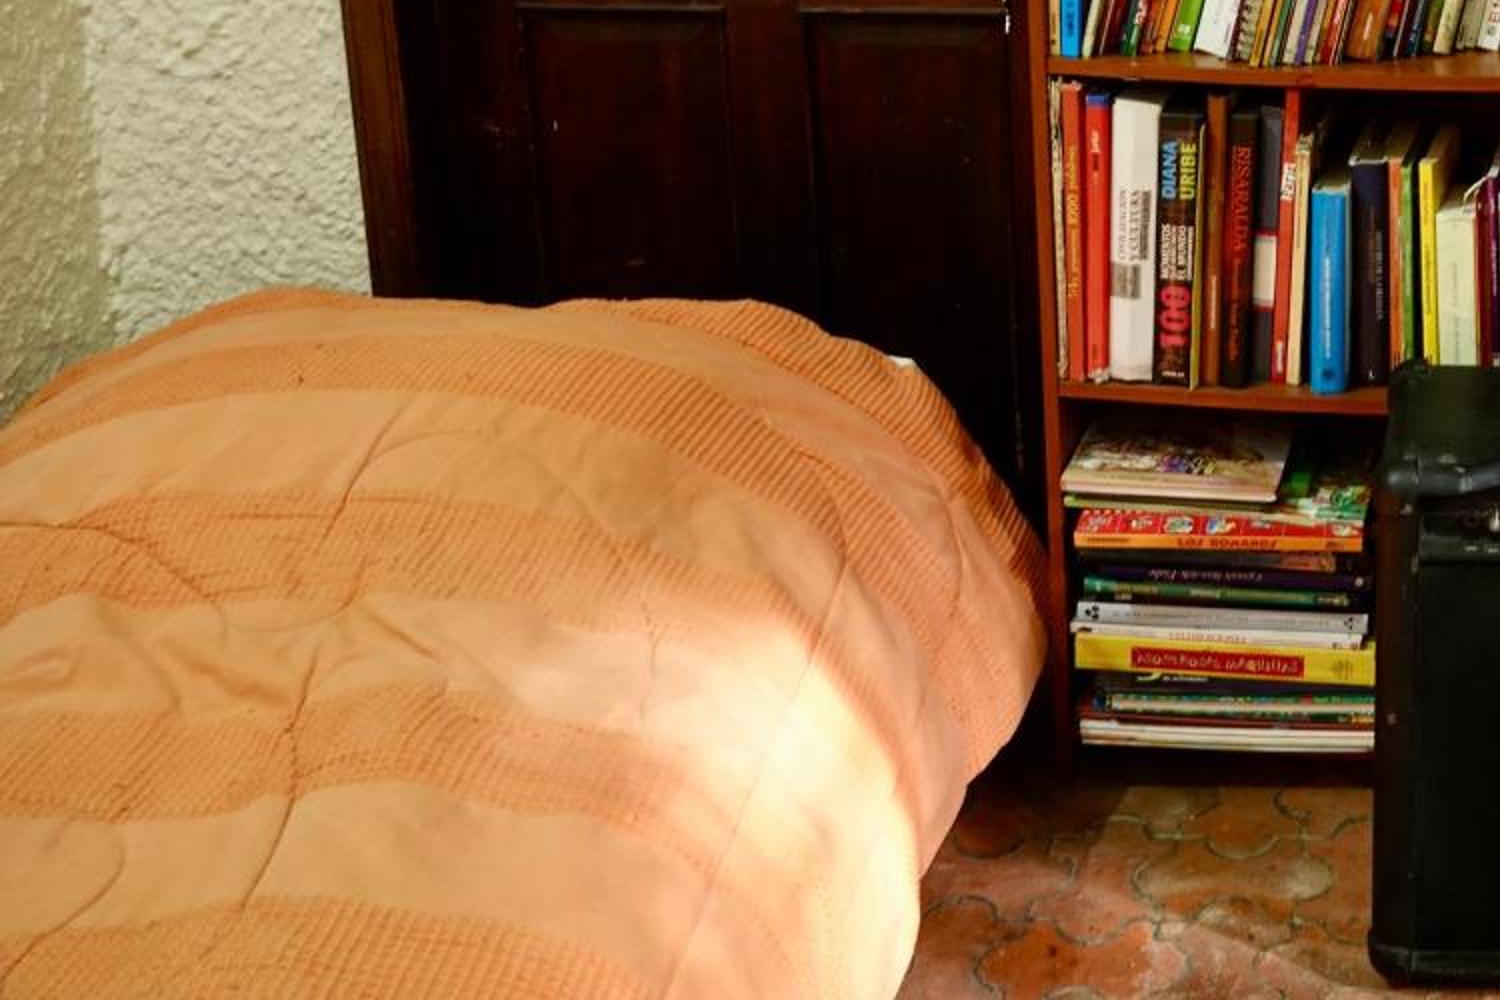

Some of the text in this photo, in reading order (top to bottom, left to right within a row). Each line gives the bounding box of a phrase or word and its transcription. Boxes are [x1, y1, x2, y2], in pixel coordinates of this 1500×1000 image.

[1487, 12, 1500, 25] El
[1160, 142, 1178, 200] DIANA
[1180, 142, 1198, 201] URIBE
[1232, 146, 1250, 252] RISARALDA
